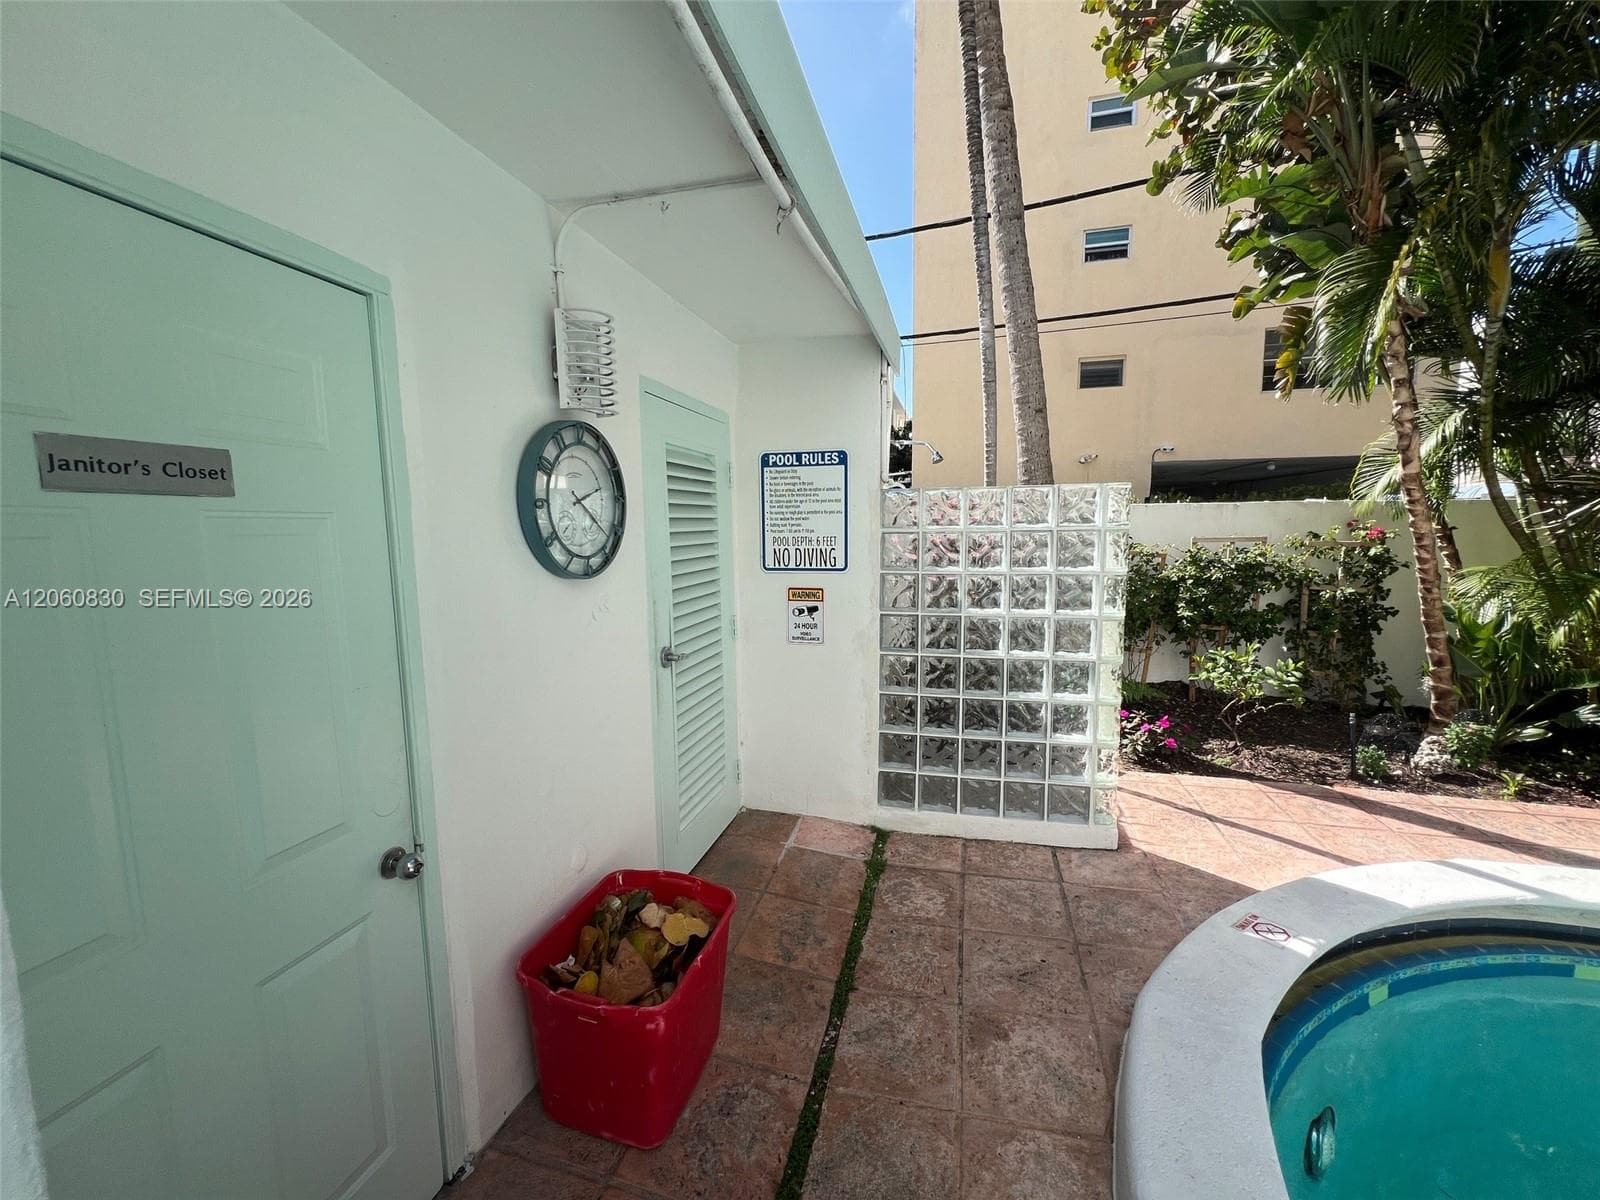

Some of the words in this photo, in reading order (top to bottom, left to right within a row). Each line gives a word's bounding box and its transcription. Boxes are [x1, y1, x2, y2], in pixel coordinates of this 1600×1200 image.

[769, 454, 799, 466] POOL
[802, 452, 840, 465] RULES
[47, 453, 151, 477] Janitor's
[162, 461, 227, 481] Closet
[772, 536, 790, 546] POOL
[792, 536, 815, 546] DEPTH:
[816, 536, 820, 546] 6
[822, 536, 837, 546] FEET
[774, 548, 790, 567] NO
[795, 548, 837, 567] DIVING
[791, 591, 820, 599] WARNING
